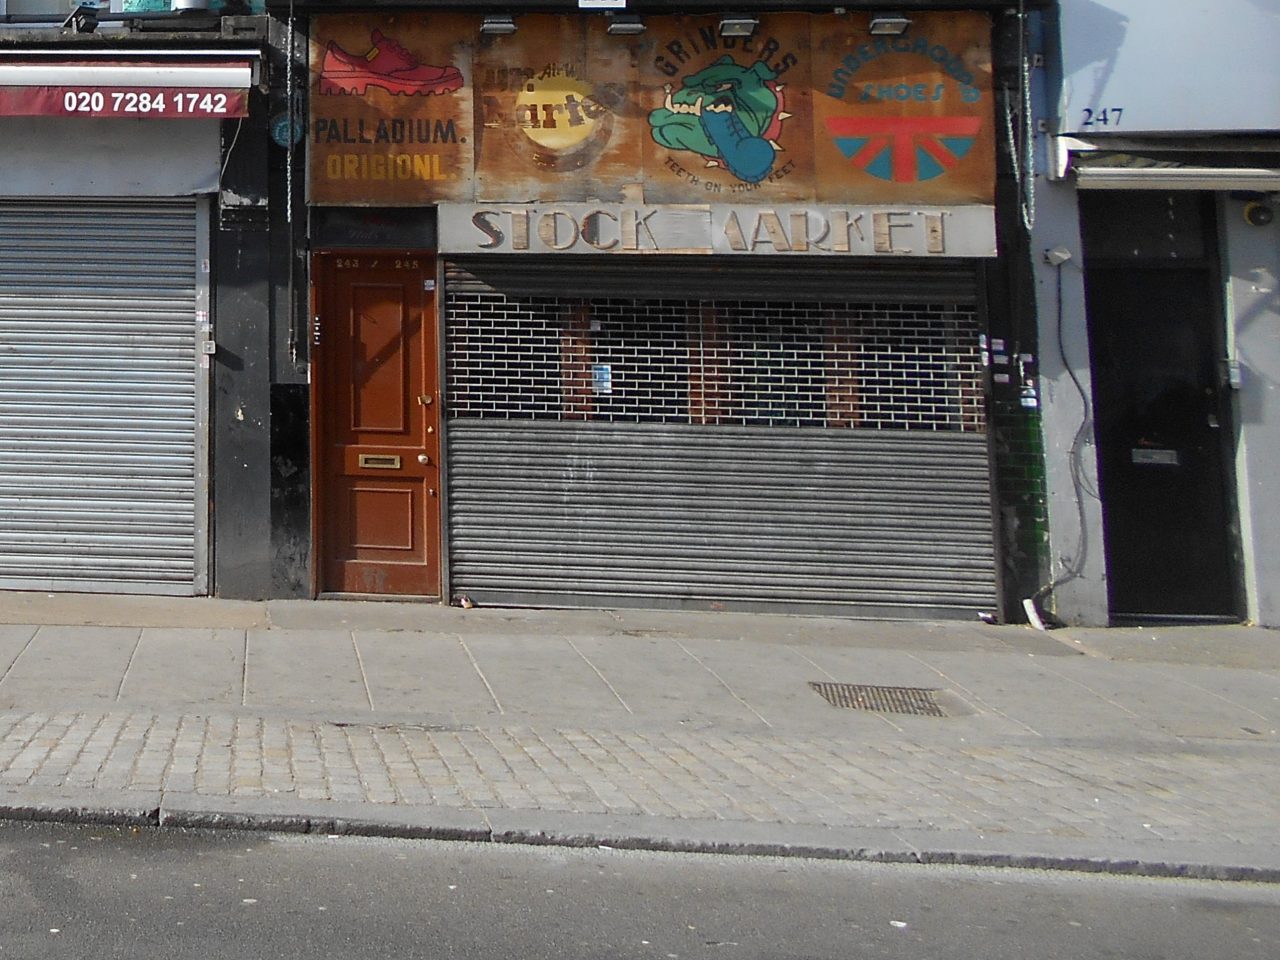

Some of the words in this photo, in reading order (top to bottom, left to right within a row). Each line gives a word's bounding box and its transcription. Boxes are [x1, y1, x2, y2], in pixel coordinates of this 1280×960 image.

[654, 24, 798, 78] GRINDERS
[64, 91, 105, 112] 020
[111, 91, 166, 113] 7284
[172, 92, 228, 114] 1742
[859, 82, 945, 102] SHOES
[1081, 107, 1124, 127] 247
[664, 155, 700, 186] TEETH
[704, 182, 722, 193] ON
[729, 183, 761, 193] YOUR
[768, 159, 798, 184] FEET
[471, 208, 660, 251] STOCK
[336, 258, 359, 268] 243
